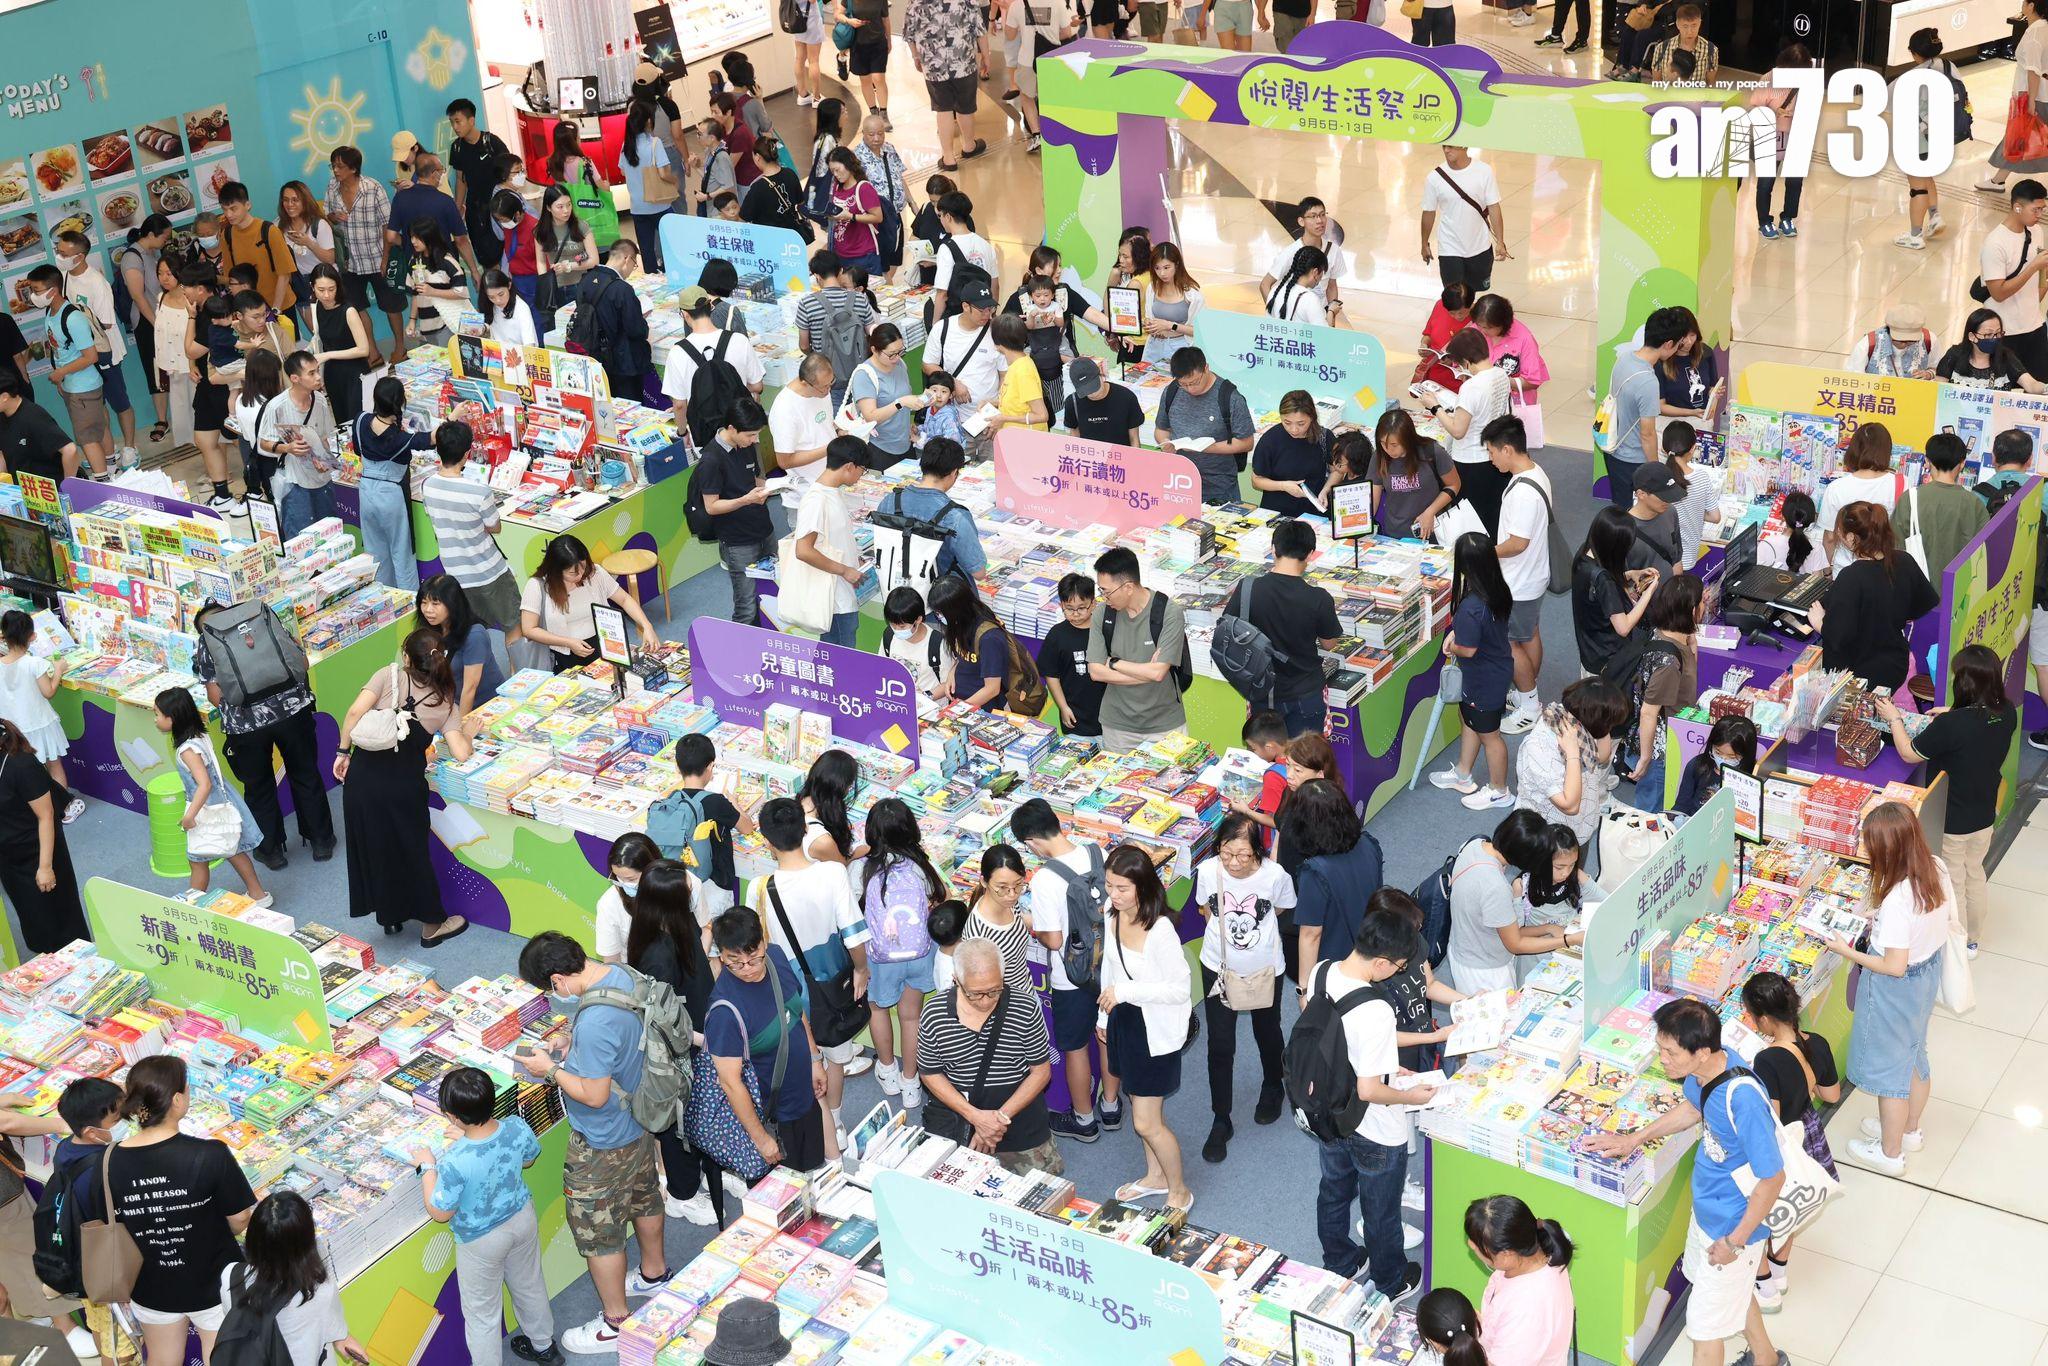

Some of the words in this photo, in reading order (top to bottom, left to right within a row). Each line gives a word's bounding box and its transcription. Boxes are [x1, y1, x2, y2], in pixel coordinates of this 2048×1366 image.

[0, 74, 69, 102] ODAY'S
[1249, 77, 1405, 121] 悅閱生活祭
[8, 93, 61, 119] MENU
[1413, 93, 1440, 109] JP
[1299, 117, 1373, 134] 9月5日-13日
[706, 234, 756, 255] 養生保健
[1259, 323, 1313, 338] 9月5日-13日
[1254, 334, 1316, 359] 生活品味
[1823, 376, 1892, 392] 9月5日-13日
[1817, 388, 1897, 416] 文具精品
[1064, 444, 1122, 461] 9月5日-13日
[1058, 455, 1126, 484] 流行讀物
[766, 638, 831, 661] 9月5日-13日
[761, 652, 835, 687] 兒童圖書
[1636, 853, 1687, 920] 生活品味
[163, 905, 229, 935] 9月5日-13日
[132, 1179, 137, 1187] I
[139, 1176, 170, 1187] KNOW.
[124, 1193, 141, 1203] FOR
[152, 1188, 188, 1199] REASON
[123, 1207, 145, 1216] WHAT
[147, 1205, 164, 1214] THE
[988, 1211, 1086, 1254] 9月5日-13日
[980, 1226, 1096, 1286] 生活品味
